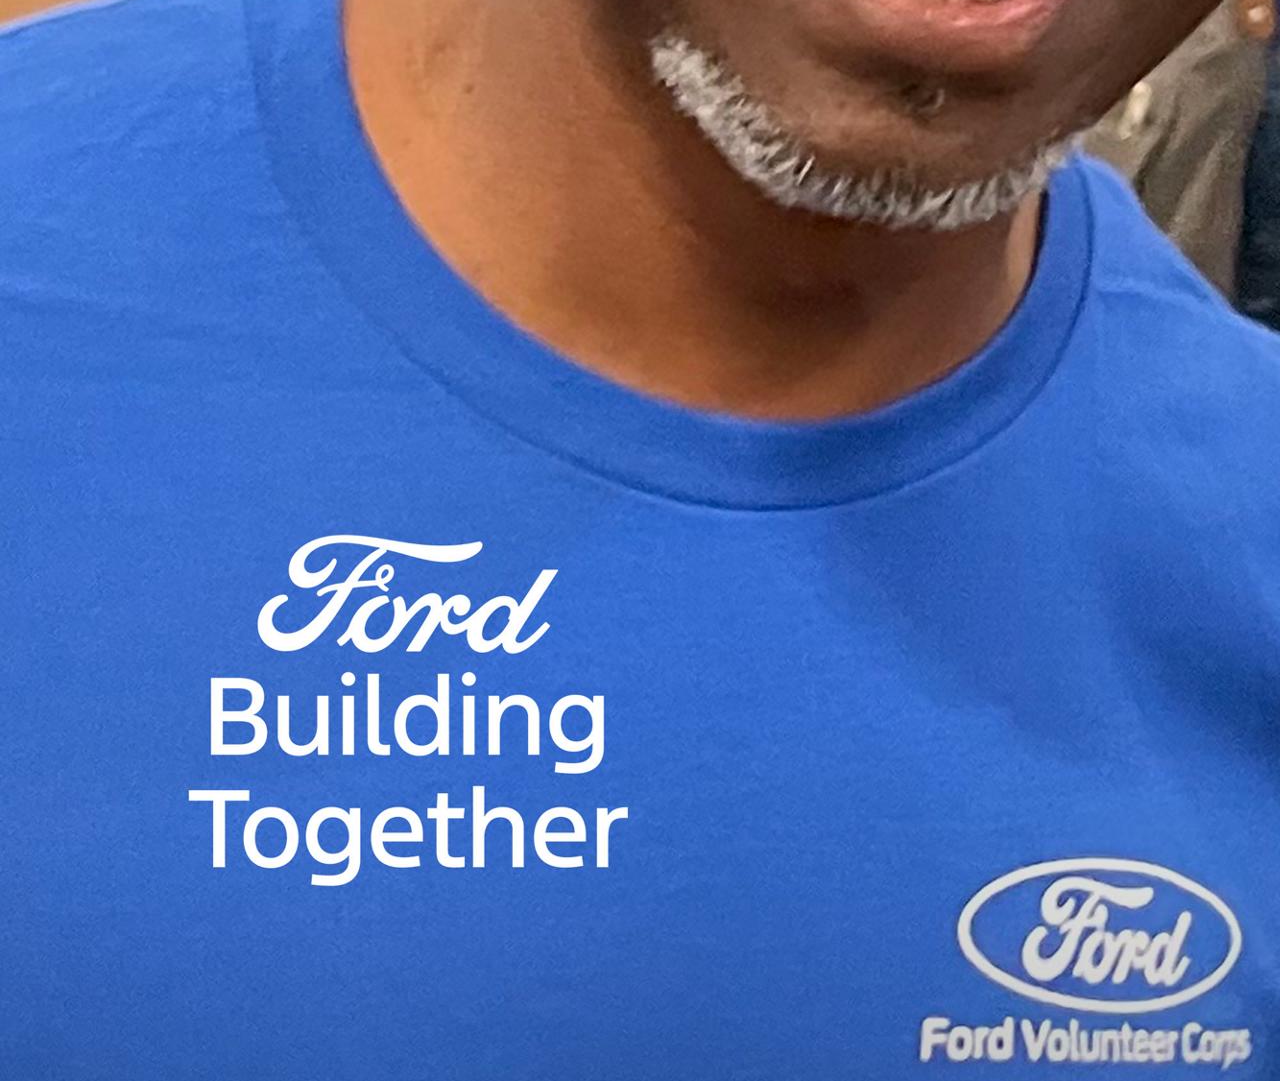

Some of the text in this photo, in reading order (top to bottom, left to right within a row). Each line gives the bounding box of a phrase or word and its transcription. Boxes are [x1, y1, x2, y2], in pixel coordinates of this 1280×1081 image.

[1022, 876, 1192, 986] Ford
[919, 1016, 1252, 1070] Ford Volunteer Corps
